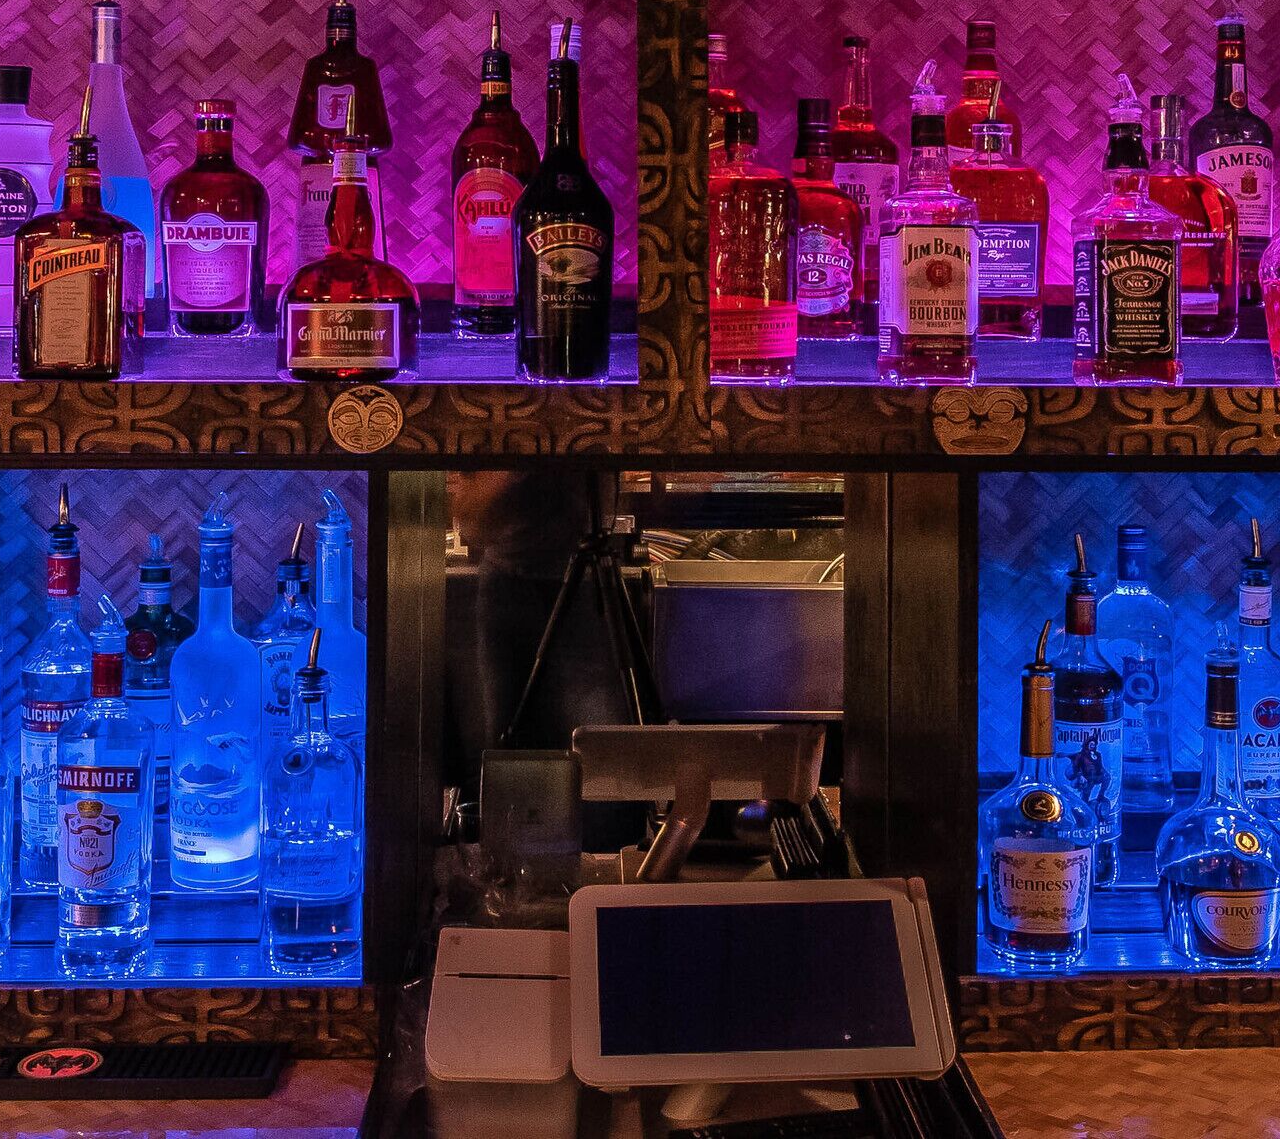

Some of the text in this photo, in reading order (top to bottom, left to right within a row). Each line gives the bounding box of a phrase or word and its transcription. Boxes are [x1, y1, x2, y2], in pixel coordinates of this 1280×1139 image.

[1208, 151, 1272, 172] JAMESO
[166, 226, 250, 241] DRAMBUIE
[532, 226, 605, 247] BAILEYS
[1184, 231, 1227, 239] RESERVE
[977, 239, 1030, 249] DEMPTION
[903, 237, 972, 267] JIM BEAM
[987, 249, 1005, 261] Rye
[32, 248, 100, 283] COINTREAU
[817, 253, 850, 270] REGAL
[1100, 249, 1173, 276] JACK DANIEL'S
[808, 271, 819, 282] 12
[540, 294, 596, 302] ORIGINAL
[1113, 297, 1162, 309] Tennessee
[909, 306, 967, 321] BOURBON
[1114, 313, 1161, 322] WHISKEY
[333, 325, 386, 341] Marnier
[1129, 662, 1152, 672] DON
[1124, 672, 1155, 700] Q
[58, 769, 135, 788] SMIRNOFF
[181, 800, 239, 816] GOOSE
[178, 838, 197, 847] FRANCE
[74, 848, 104, 858] VODKA
[1002, 872, 1077, 893] Hennessy
